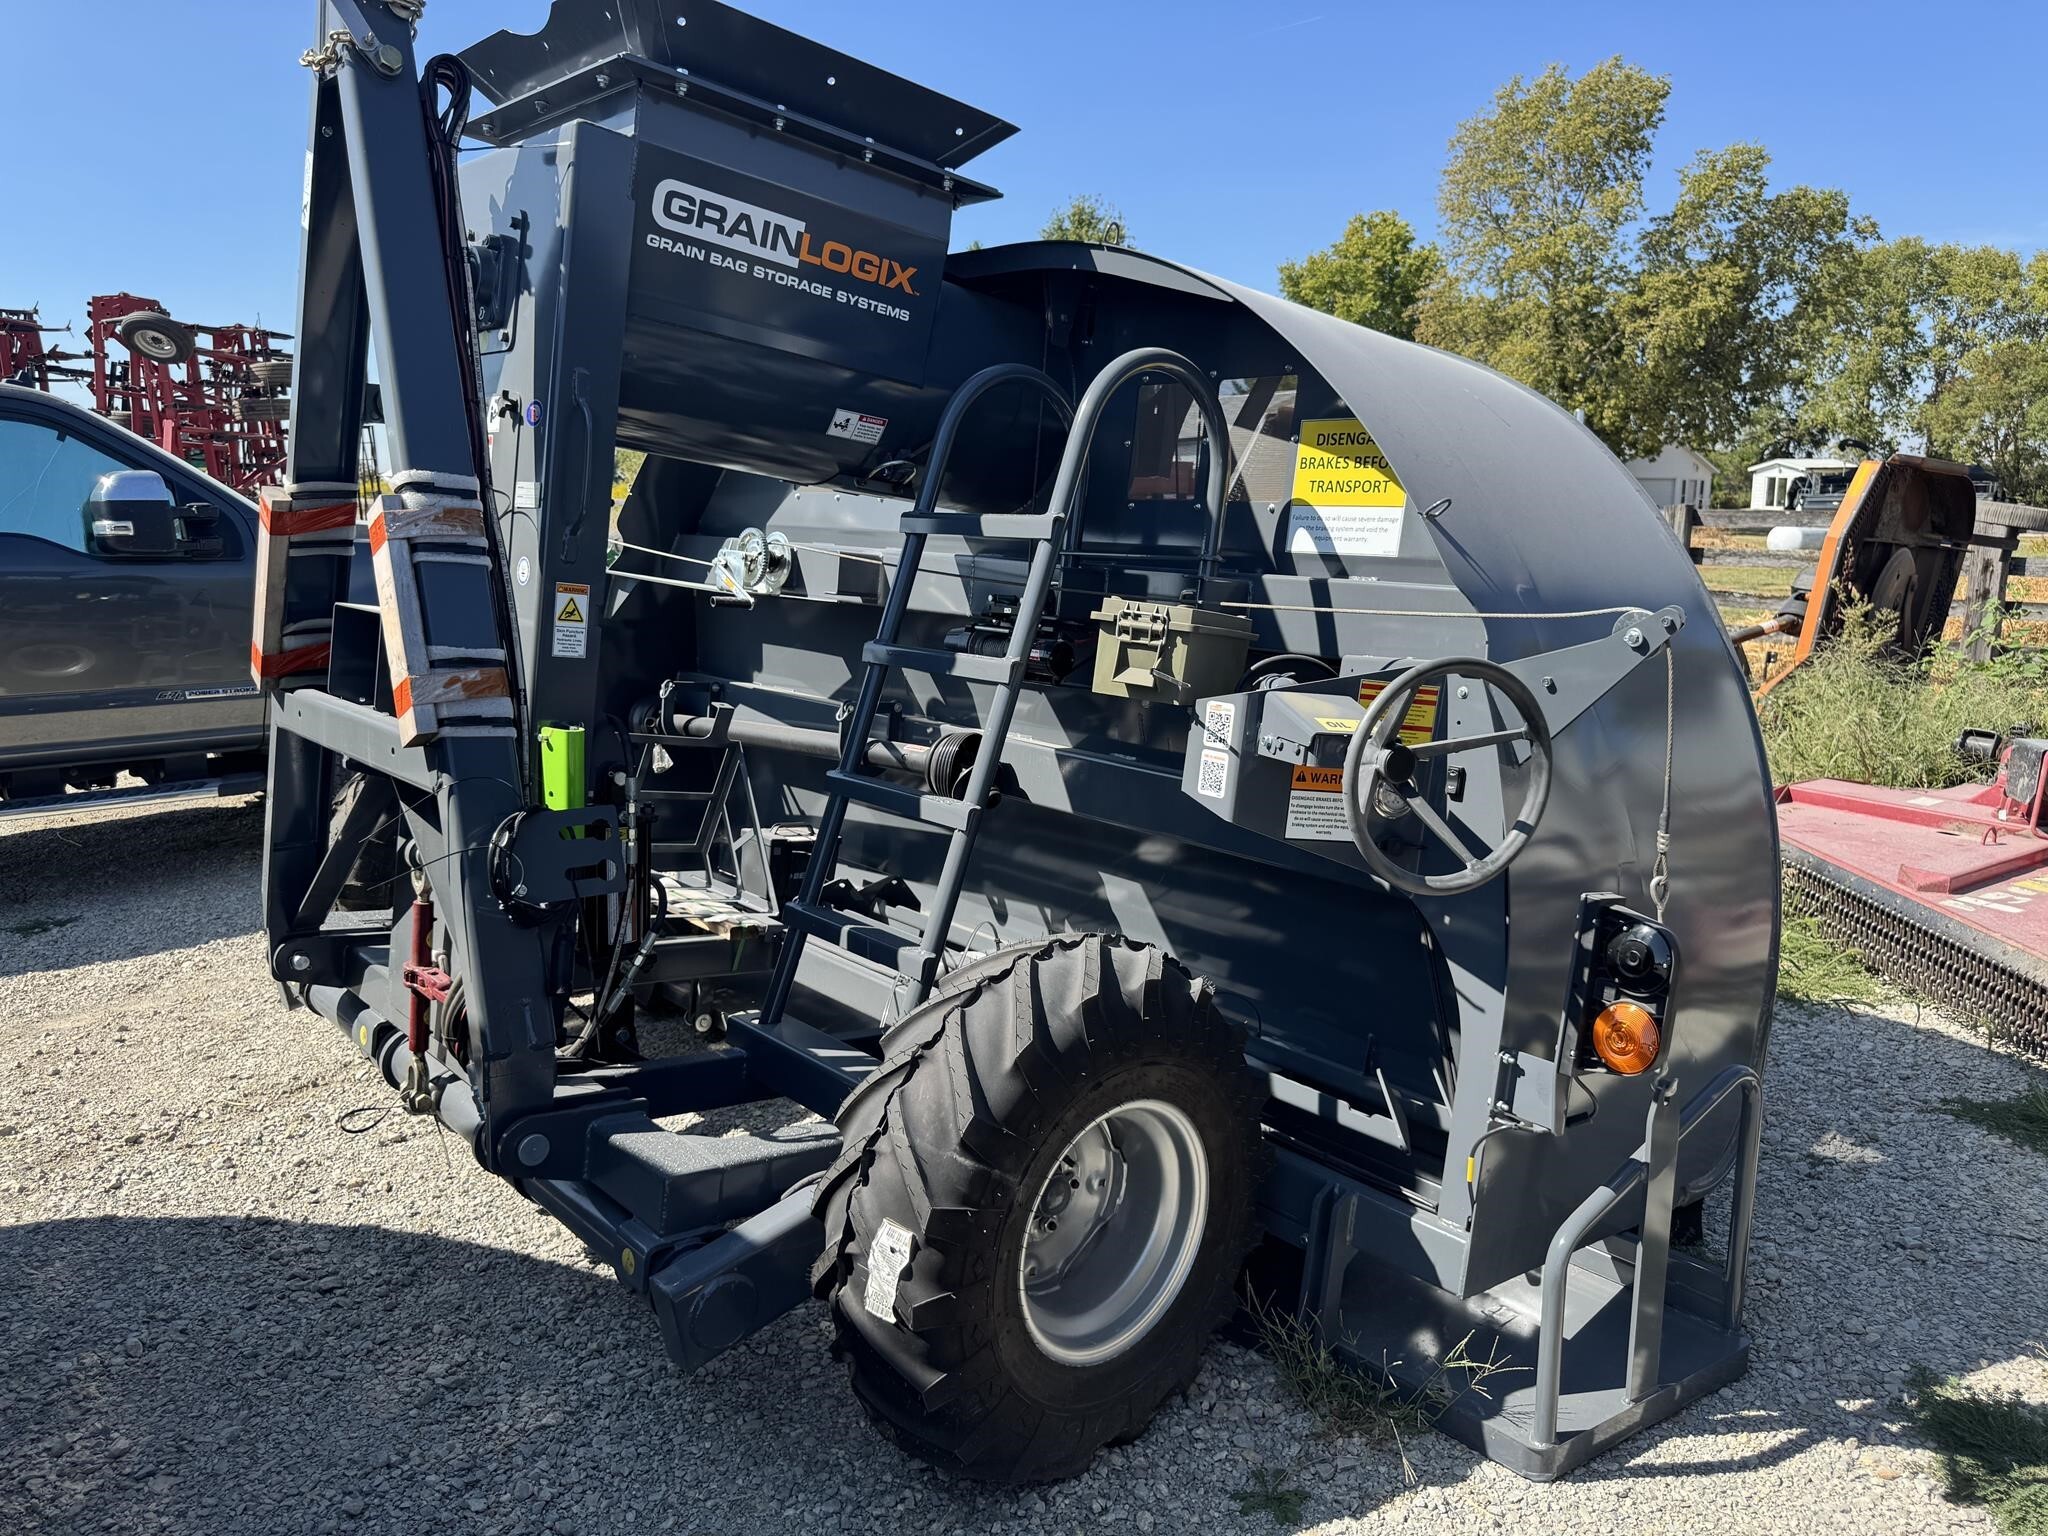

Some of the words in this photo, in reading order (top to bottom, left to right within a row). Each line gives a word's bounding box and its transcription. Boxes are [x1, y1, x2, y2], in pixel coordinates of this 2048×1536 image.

[646, 233, 706, 261] GRAIN
[709, 250, 748, 274] BAG
[752, 265, 832, 299] STORAGE
[836, 290, 910, 322] SYSTEMS
[1316, 432, 1376, 446] DISENGA
[1300, 456, 1349, 470] BRAKES
[1354, 456, 1391, 469] BEFO
[1309, 480, 1391, 494] TRANSPORT
[1376, 516, 1400, 524] damage
[189, 689, 220, 697] POWER
[1310, 772, 1343, 785] WARN
